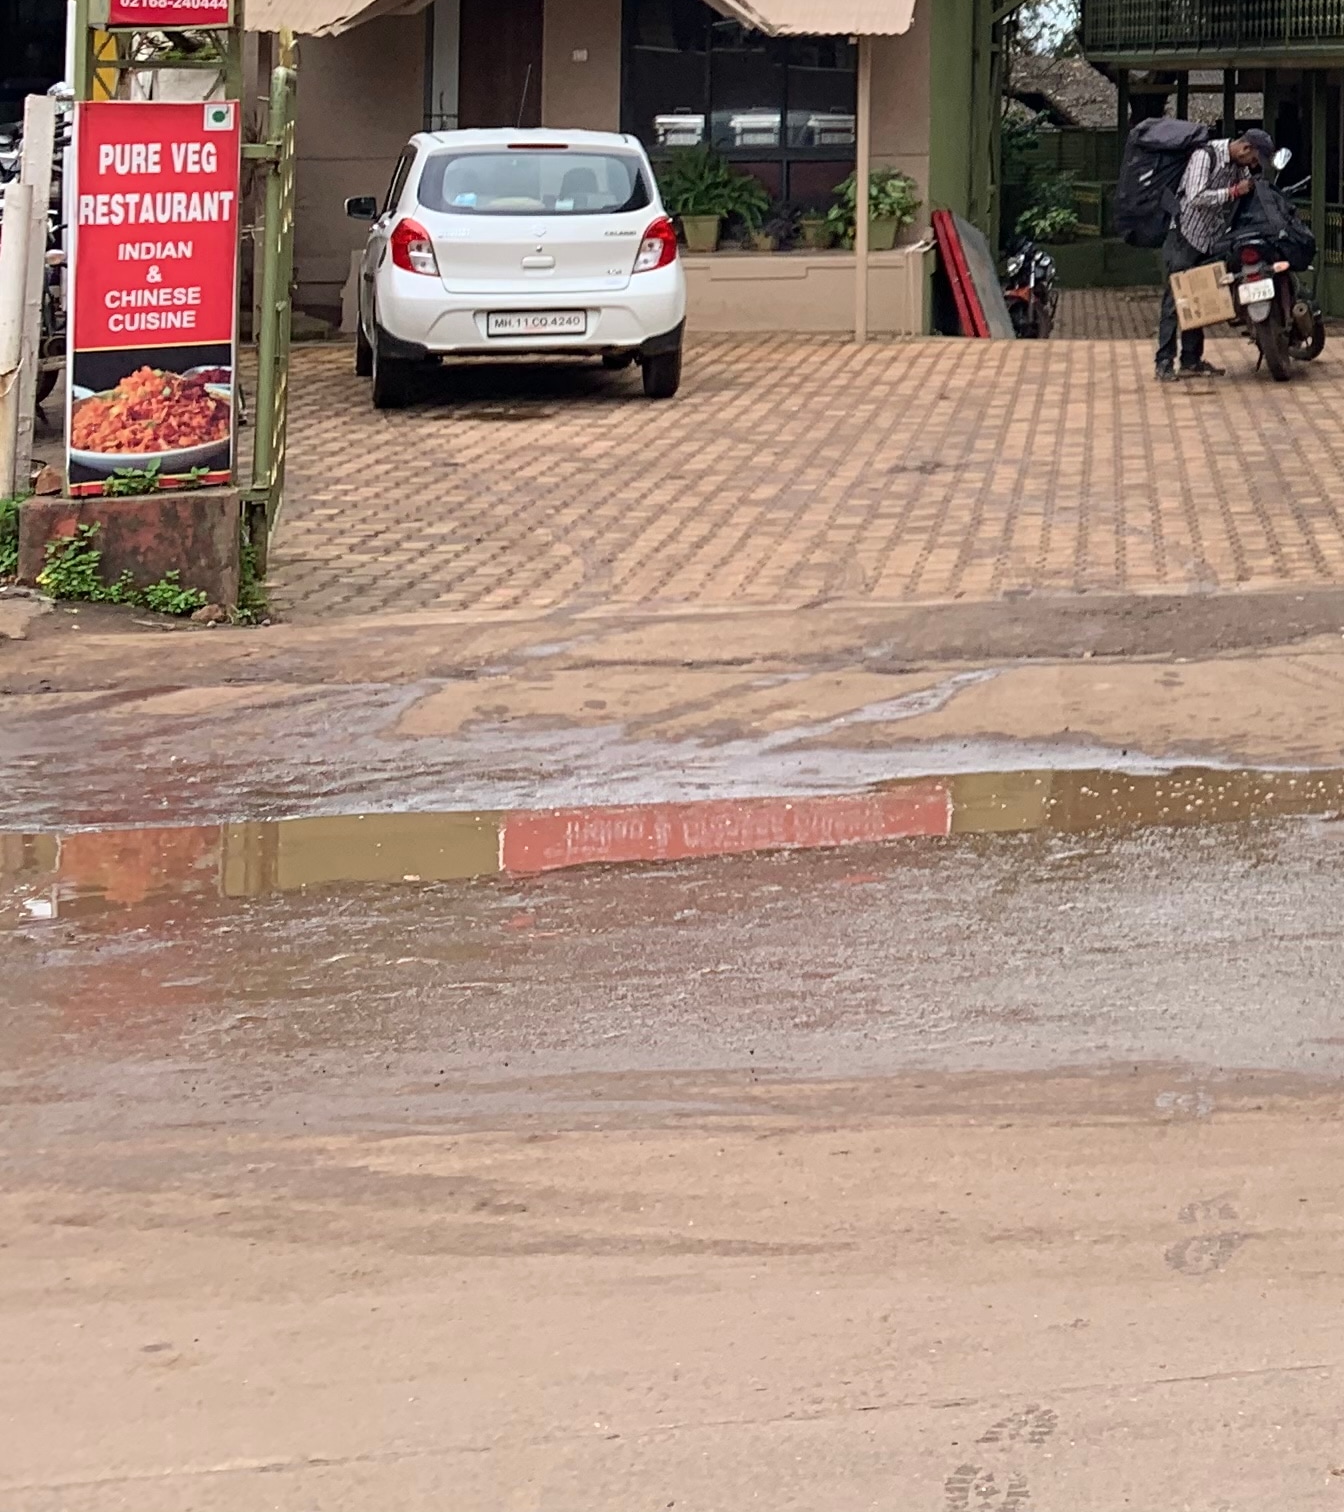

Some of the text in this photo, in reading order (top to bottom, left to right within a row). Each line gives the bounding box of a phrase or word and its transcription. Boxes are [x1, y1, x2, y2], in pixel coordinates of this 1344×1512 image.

[98, 142, 218, 175] PURE VEG
[78, 190, 234, 227] RESTAURANT
[117, 240, 193, 261] INDIAN
[145, 265, 163, 283] &
[104, 287, 201, 309] CHINESE
[107, 310, 196, 332] CUISINE
